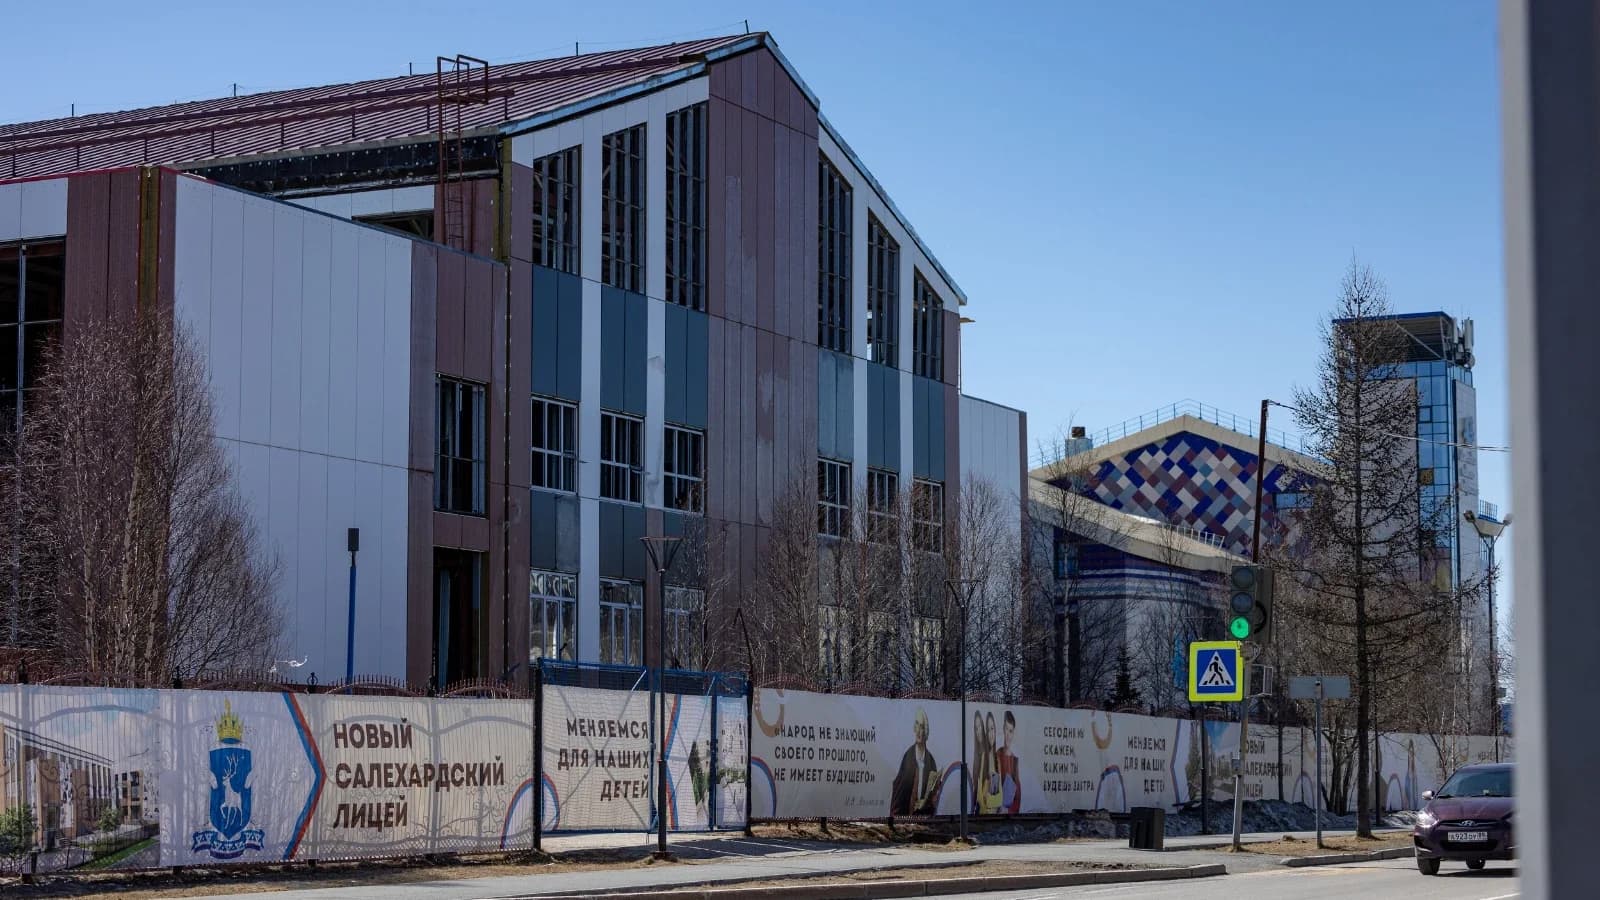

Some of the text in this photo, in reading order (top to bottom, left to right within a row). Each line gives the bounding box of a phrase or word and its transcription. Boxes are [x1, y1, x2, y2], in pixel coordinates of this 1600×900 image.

[333, 717, 412, 748] НОВЫЙ
[566, 717, 649, 739] МЕНЯЕМСЯ
[774, 725, 876, 743] «НАРОД НЕ ЗНАЮЩИЙ
[774, 746, 868, 766] СВОЕГО ПРОШЛОГО,
[1246, 737, 1265, 754] ОВЫЙ
[558, 748, 649, 770] ДЛЯ НАШИХ
[335, 755, 504, 792] САЛЕХАРДСКИЙ
[774, 768, 875, 784] НЕ ИМЕЕТ БУДУЩЕГО»
[600, 774, 649, 801] ДЕТЕЙ
[333, 795, 407, 832] ЛИЦЕЙ
